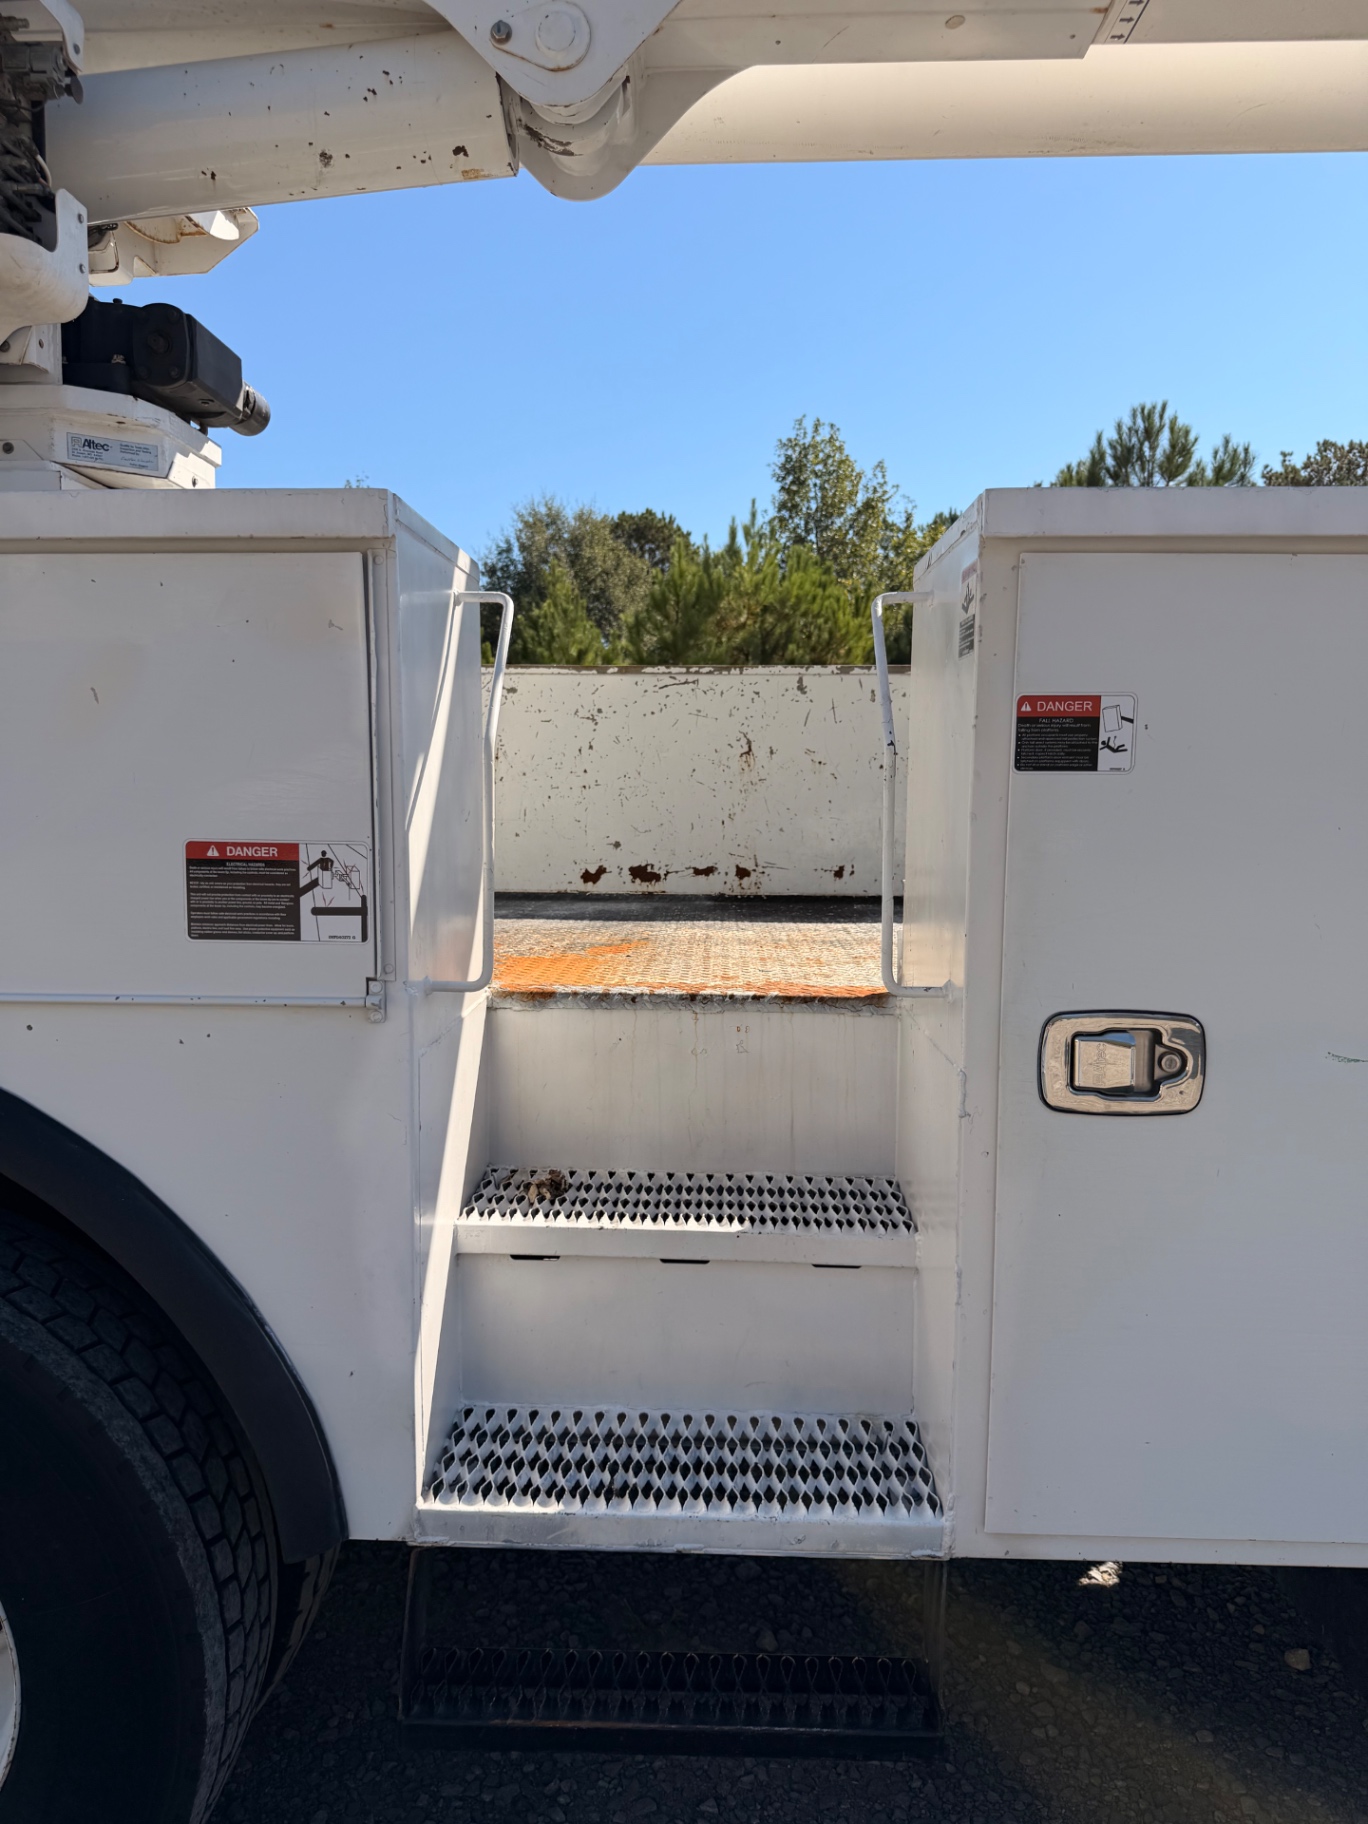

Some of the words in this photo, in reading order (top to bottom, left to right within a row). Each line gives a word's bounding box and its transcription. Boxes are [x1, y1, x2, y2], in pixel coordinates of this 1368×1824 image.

[82, 438, 110, 452] Altec
[1037, 701, 1092, 711] DANGER
[226, 846, 278, 857] DANGER
